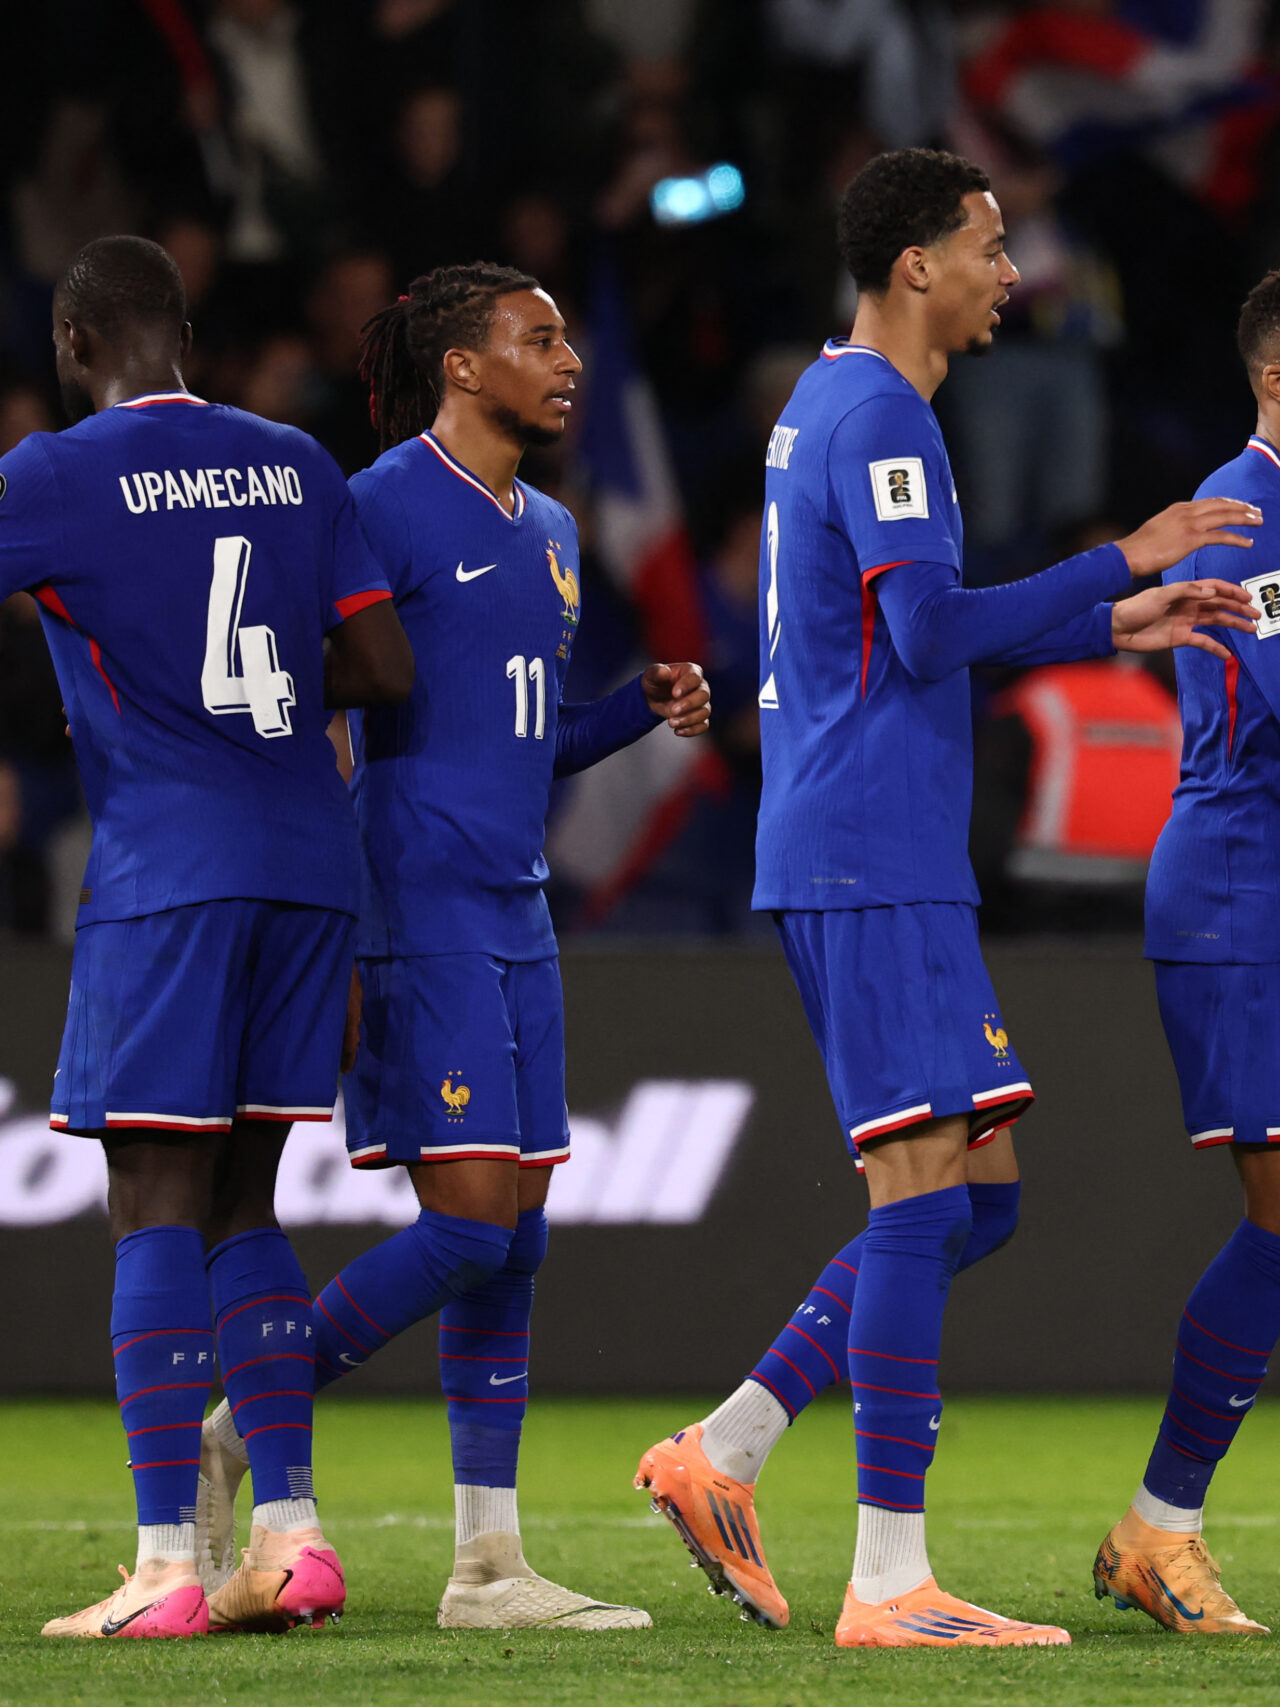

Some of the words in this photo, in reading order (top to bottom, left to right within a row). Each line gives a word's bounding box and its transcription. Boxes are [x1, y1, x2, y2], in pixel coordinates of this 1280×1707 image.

[119, 465, 303, 515] UPAMECANO
[201, 535, 297, 739] 4
[506, 654, 546, 740] 11
